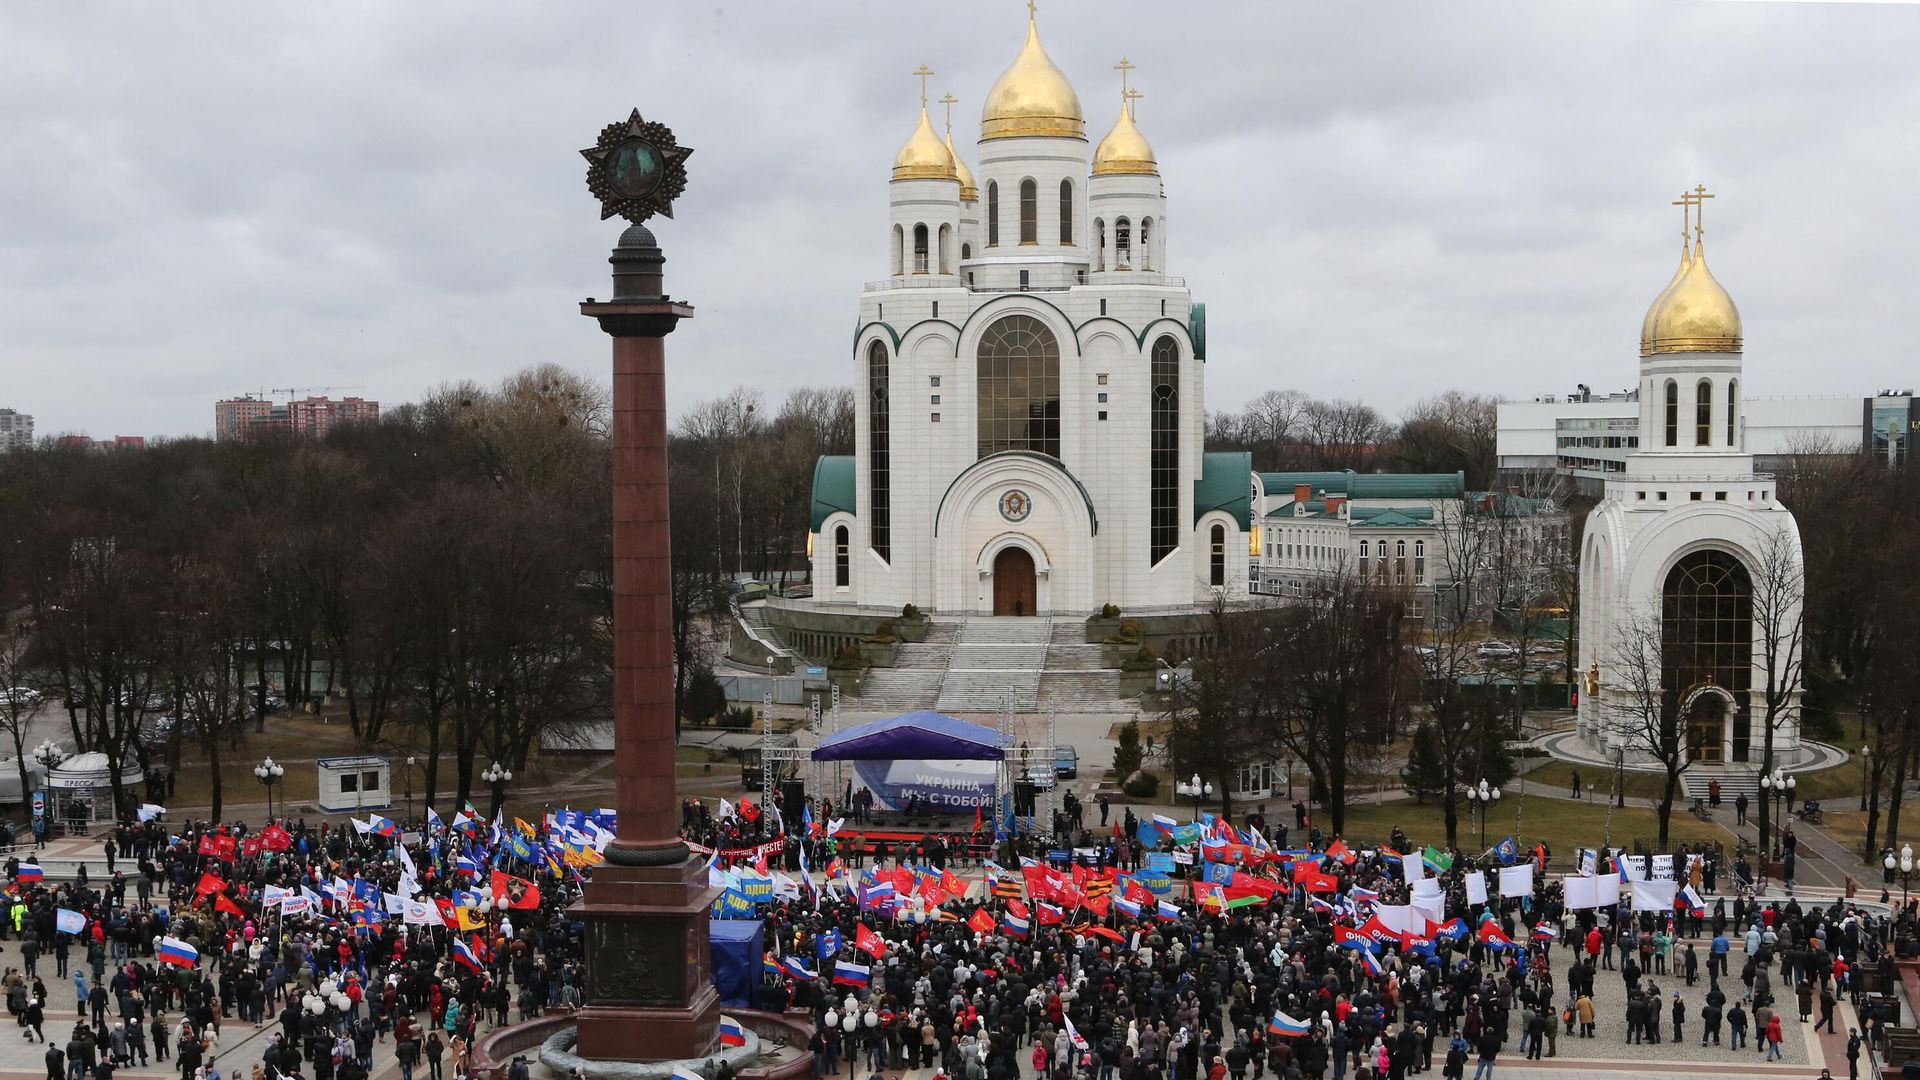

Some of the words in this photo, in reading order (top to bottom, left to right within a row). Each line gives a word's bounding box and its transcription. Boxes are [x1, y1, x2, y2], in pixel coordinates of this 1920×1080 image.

[915, 774, 984, 794] УКРАИНА,
[929, 793, 939, 804] С
[943, 793, 994, 808] ТОБОЙ!
[745, 883, 772, 897] ЛДПР
[1345, 931, 1372, 947] ФНПР
